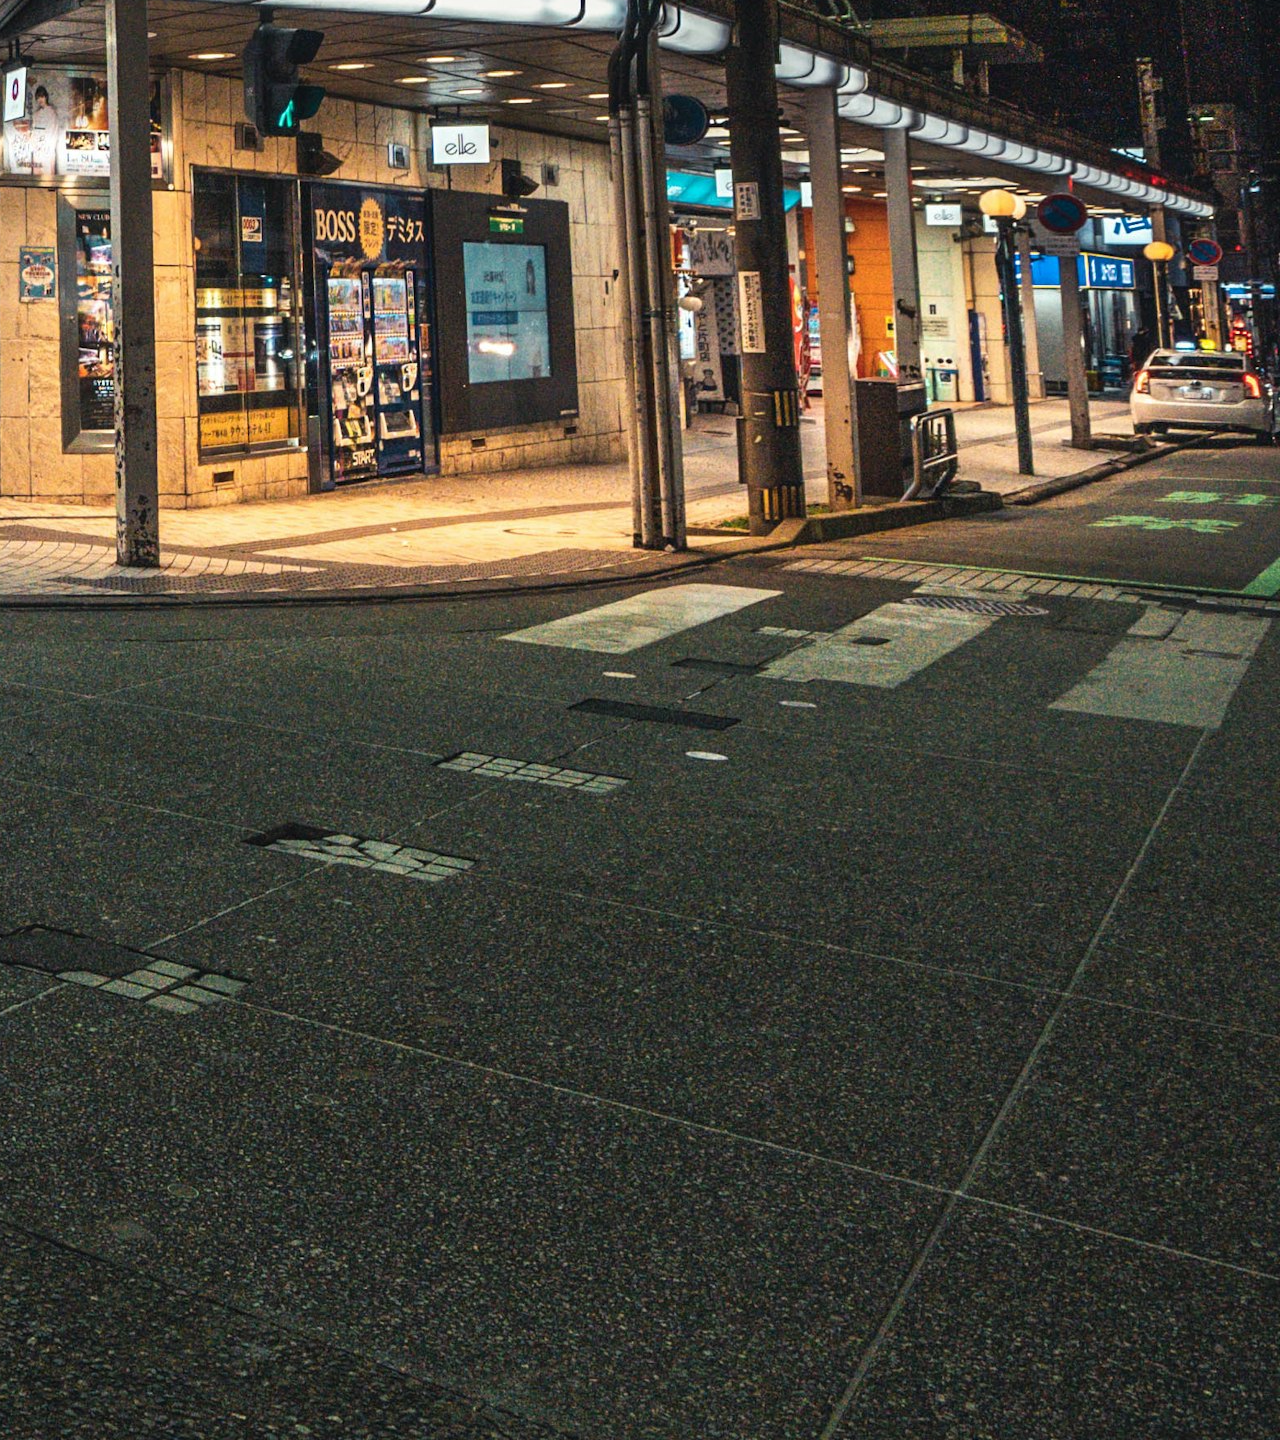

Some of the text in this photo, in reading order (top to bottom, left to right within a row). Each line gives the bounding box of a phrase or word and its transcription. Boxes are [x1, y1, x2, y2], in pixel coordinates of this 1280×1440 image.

[443, 132, 478, 157] elle
[314, 207, 357, 243] BOSS
[386, 215, 425, 243] デミタス
